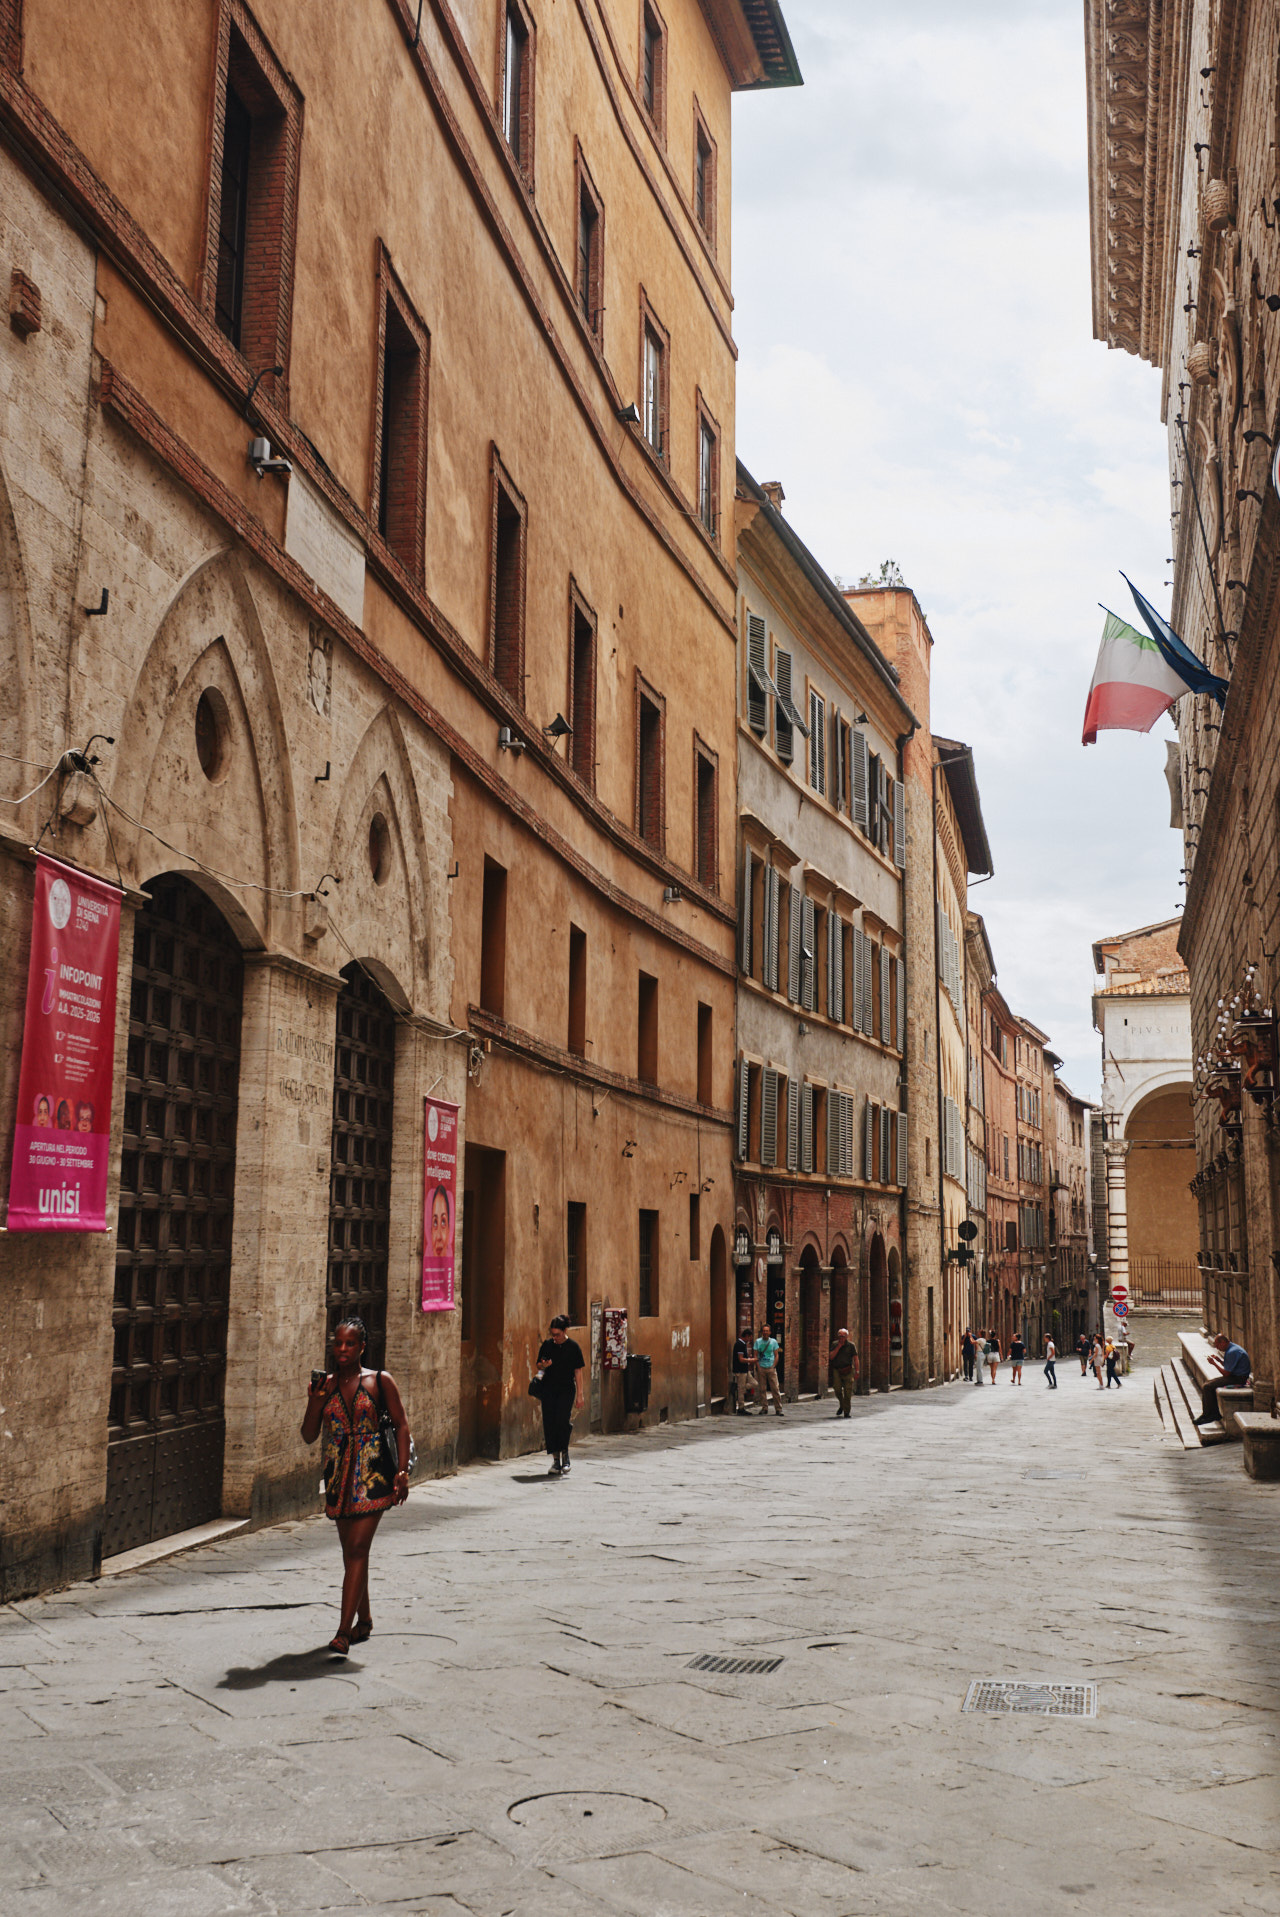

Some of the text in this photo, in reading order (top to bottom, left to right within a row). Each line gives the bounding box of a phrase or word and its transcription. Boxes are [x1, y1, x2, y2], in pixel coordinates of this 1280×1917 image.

[76, 906, 99, 924] DI SIENA
[77, 895, 109, 917] UNIVERSITÀ
[60, 963, 103, 990] INFOPOINT
[59, 988, 101, 1009] IMMATRICOLAZIONI
[70, 1005, 101, 1023] 2025-2026
[30, 1141, 87, 1155] APERTURA NEL PERIODO
[427, 1147, 455, 1164] dove crescono
[29, 1155, 36, 1164] 30
[36, 1155, 57, 1166] GIUGNO
[60, 1157, 66, 1167] 30
[66, 1158, 94, 1169] SETTEMBRE
[427, 1164, 452, 1181] intelligenze
[38, 1181, 80, 1214] unisi
